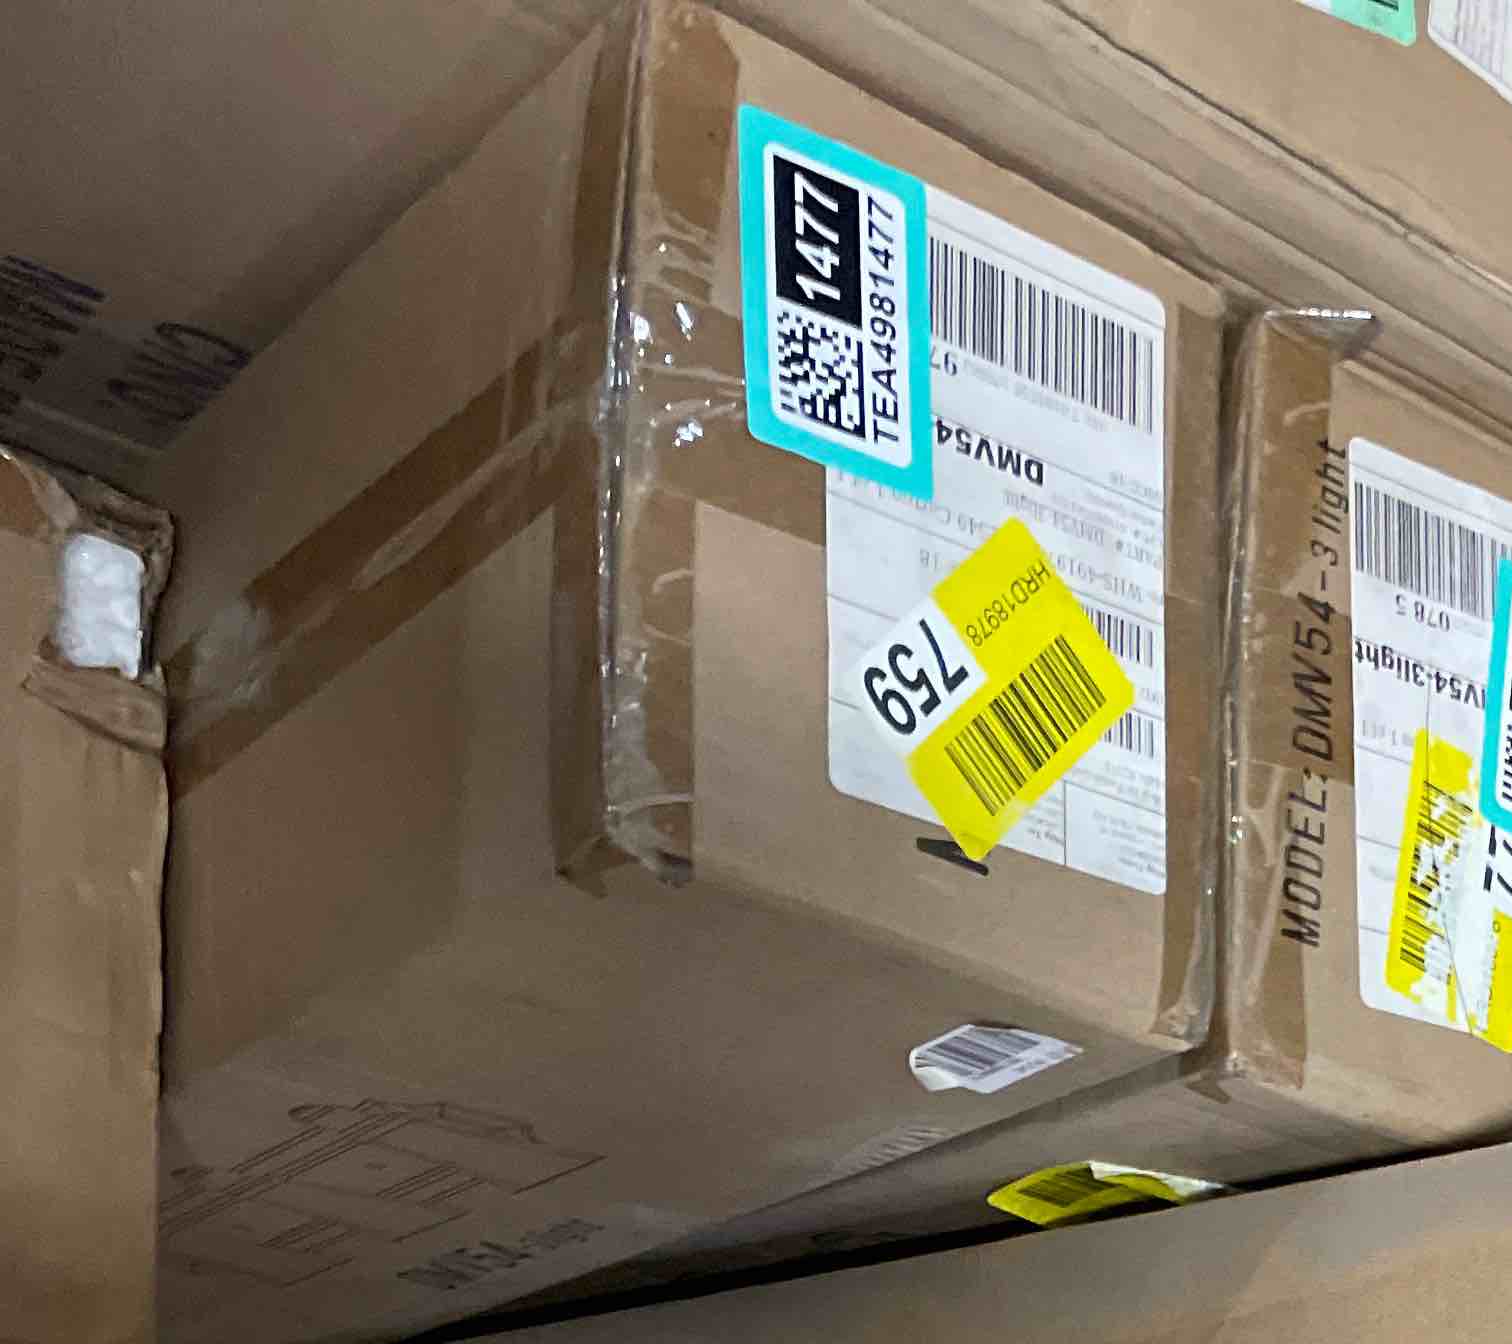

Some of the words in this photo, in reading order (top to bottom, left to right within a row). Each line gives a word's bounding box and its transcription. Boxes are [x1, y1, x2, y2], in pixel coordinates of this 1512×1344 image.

[796, 171, 842, 303] 1477
[866, 195, 901, 447] TEA4981477
[936, 418, 1044, 487] DMV54
[965, 558, 1051, 648] HRD18978
[863, 618, 969, 735] 759
